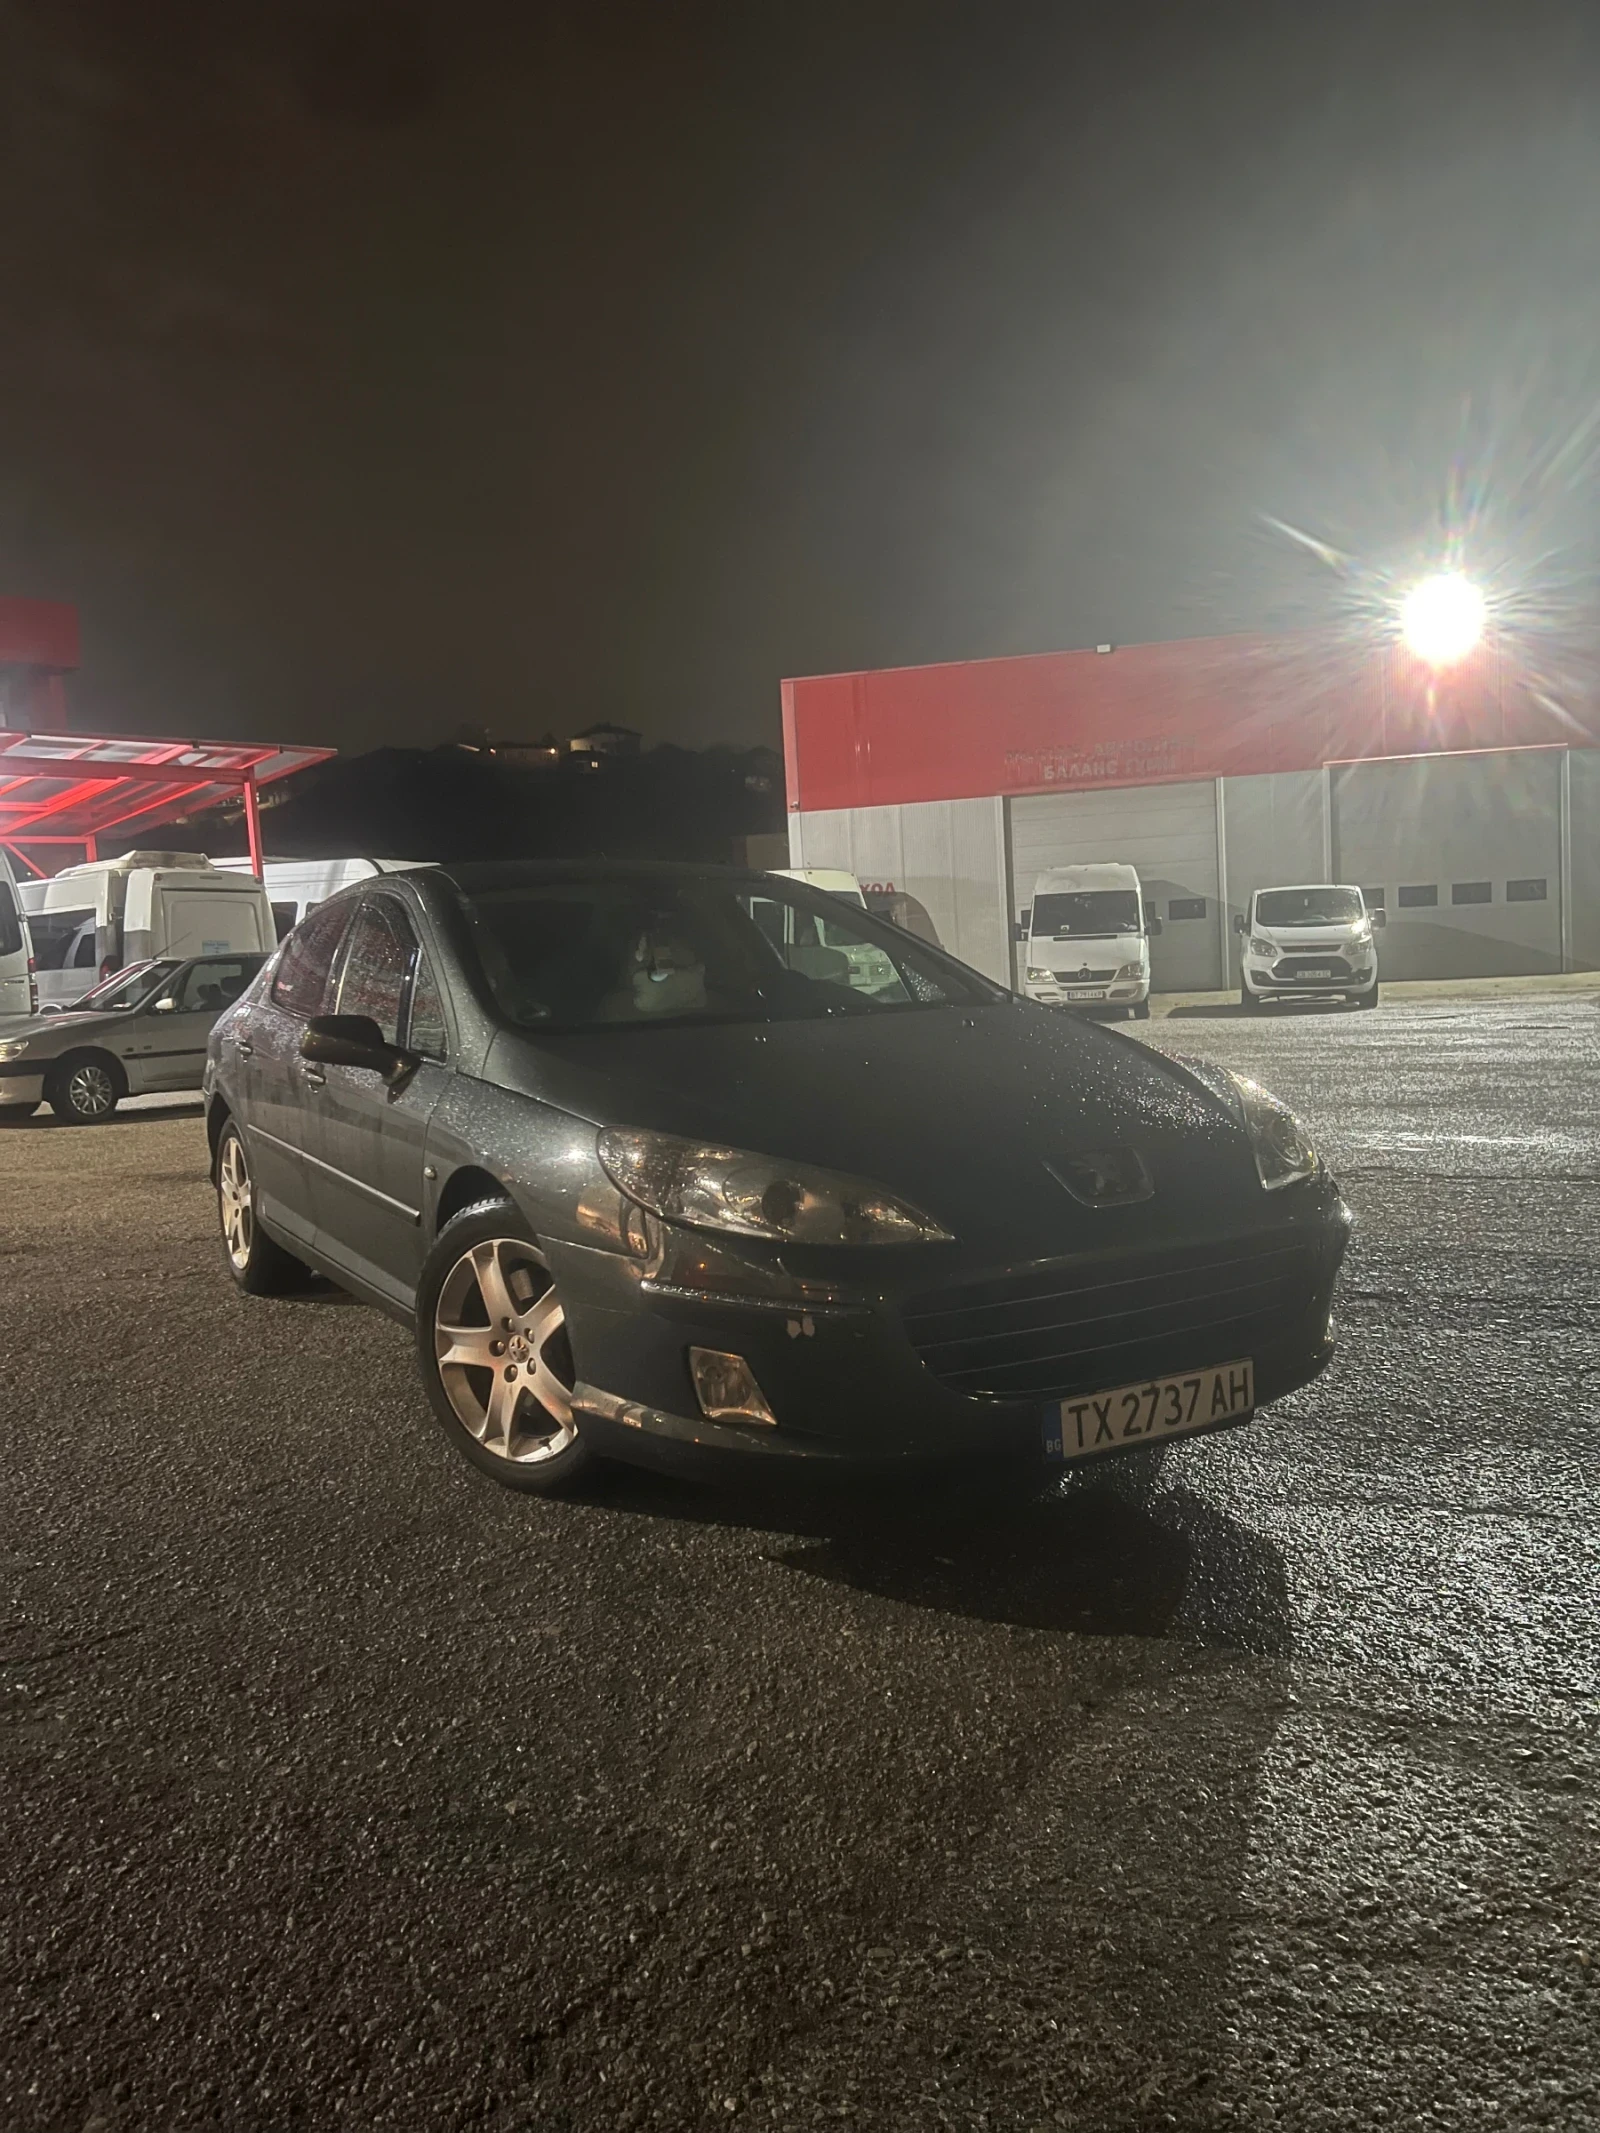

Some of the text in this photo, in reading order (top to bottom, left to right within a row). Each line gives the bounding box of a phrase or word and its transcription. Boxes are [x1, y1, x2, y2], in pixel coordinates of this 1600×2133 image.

[1043, 760, 1118, 780] БАЛАНС
[1067, 1367, 1249, 1448] TX 2737 AH
[1046, 1438, 1061, 1454] BG
